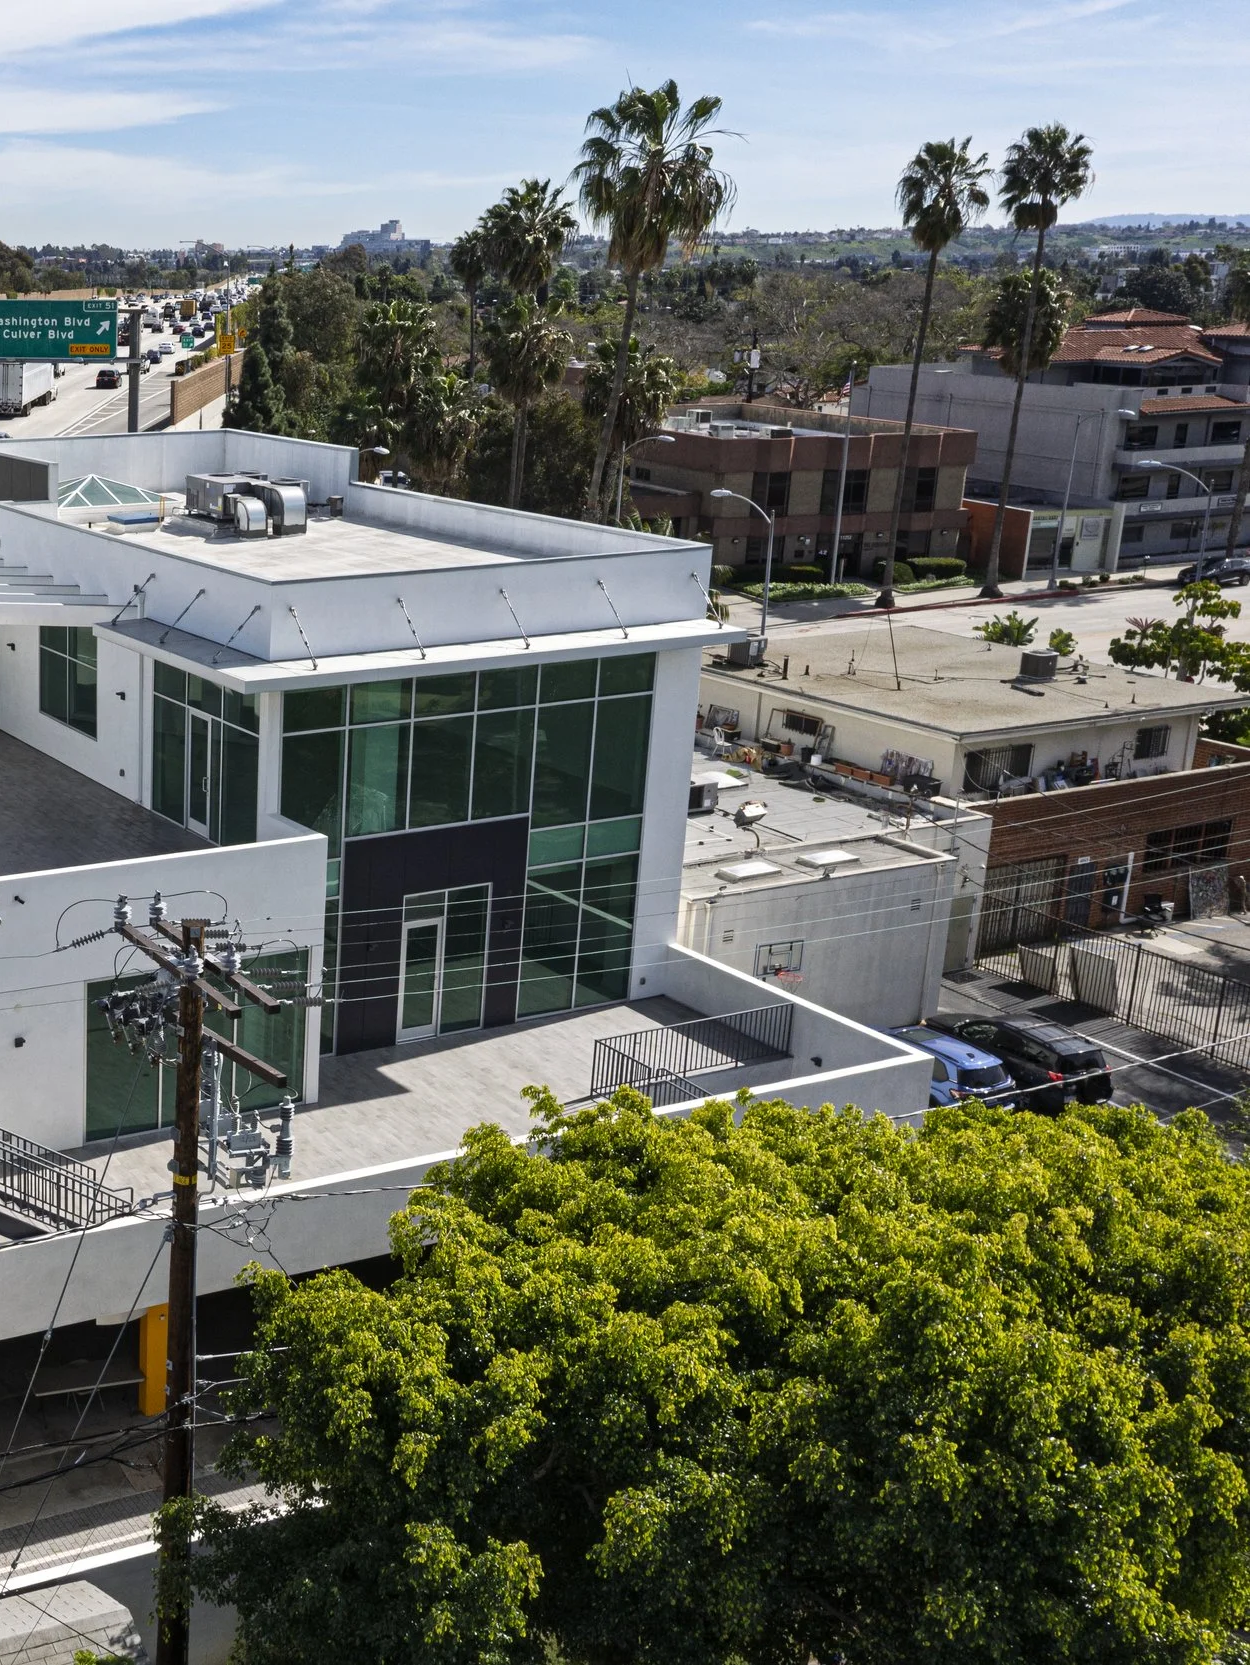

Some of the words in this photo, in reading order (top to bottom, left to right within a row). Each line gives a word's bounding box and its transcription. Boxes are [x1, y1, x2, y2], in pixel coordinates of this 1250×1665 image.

[64, 317, 91, 326] Blvd
[3, 329, 42, 339] Culver
[48, 330, 74, 339] Blvd
